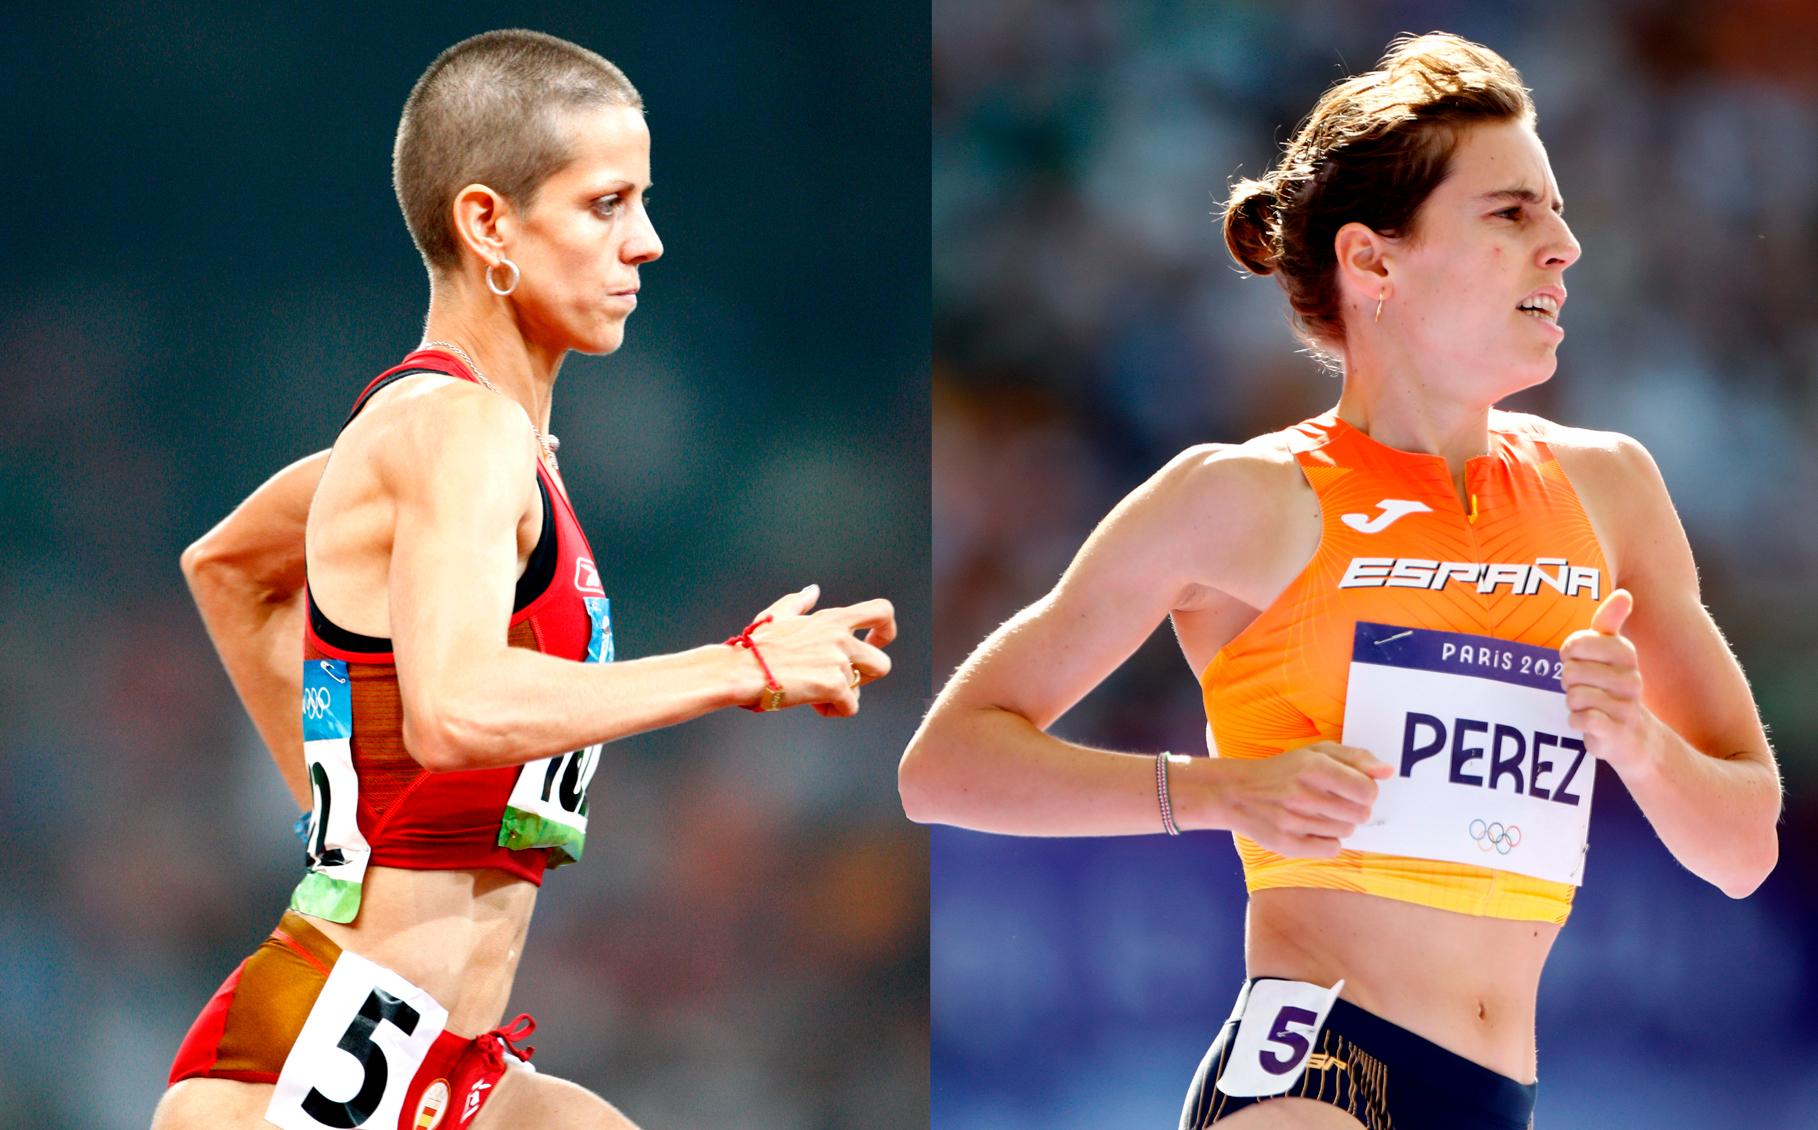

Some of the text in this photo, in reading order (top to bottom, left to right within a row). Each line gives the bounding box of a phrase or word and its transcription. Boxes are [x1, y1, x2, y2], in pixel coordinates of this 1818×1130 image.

[1338, 557, 1600, 600] ESPAÑA
[1520, 655, 1564, 680] 202
[1399, 711, 1587, 806] PEREZ
[301, 985, 421, 1129] 5
[1259, 1006, 1318, 1075] 5
